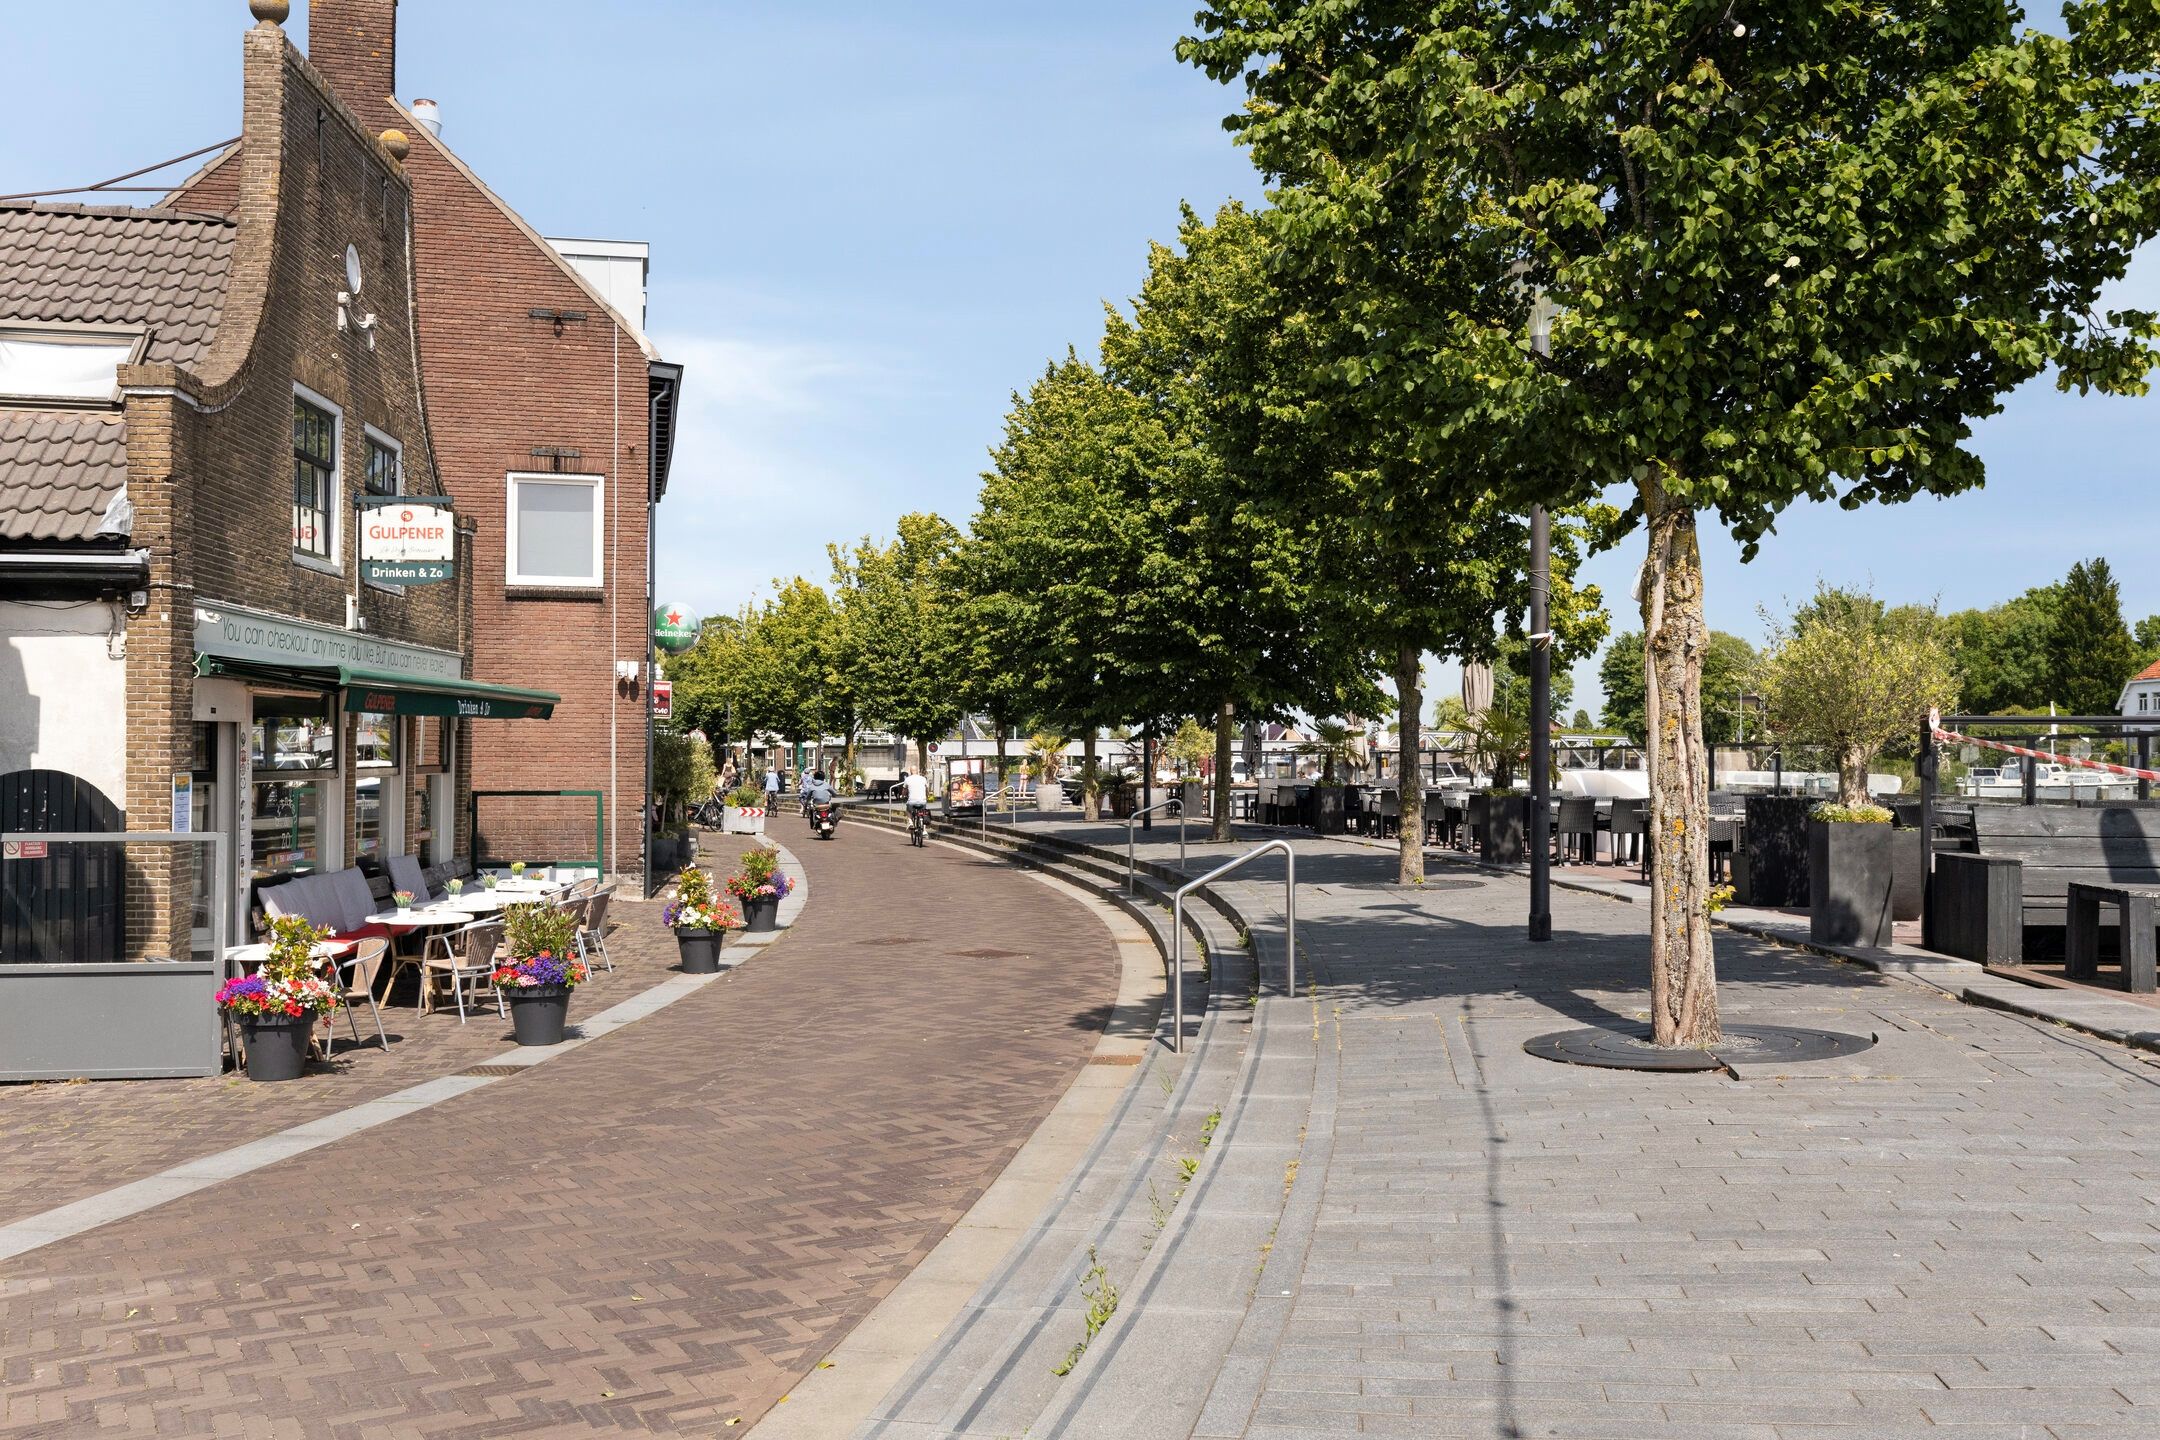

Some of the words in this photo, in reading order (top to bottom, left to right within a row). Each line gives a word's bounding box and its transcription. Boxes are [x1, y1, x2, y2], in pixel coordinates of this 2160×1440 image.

[370, 525, 444, 540] GULPENER
[371, 567, 416, 578] Drinken
[418, 567, 427, 578] &
[429, 567, 444, 578] Zo
[244, 626, 264, 646] can
[267, 626, 309, 654] checkout
[312, 637, 328, 660] any
[328, 636, 347, 659] time
[347, 643, 362, 665] you
[365, 693, 395, 710] GULPENER
[457, 699, 479, 715] Drinken
